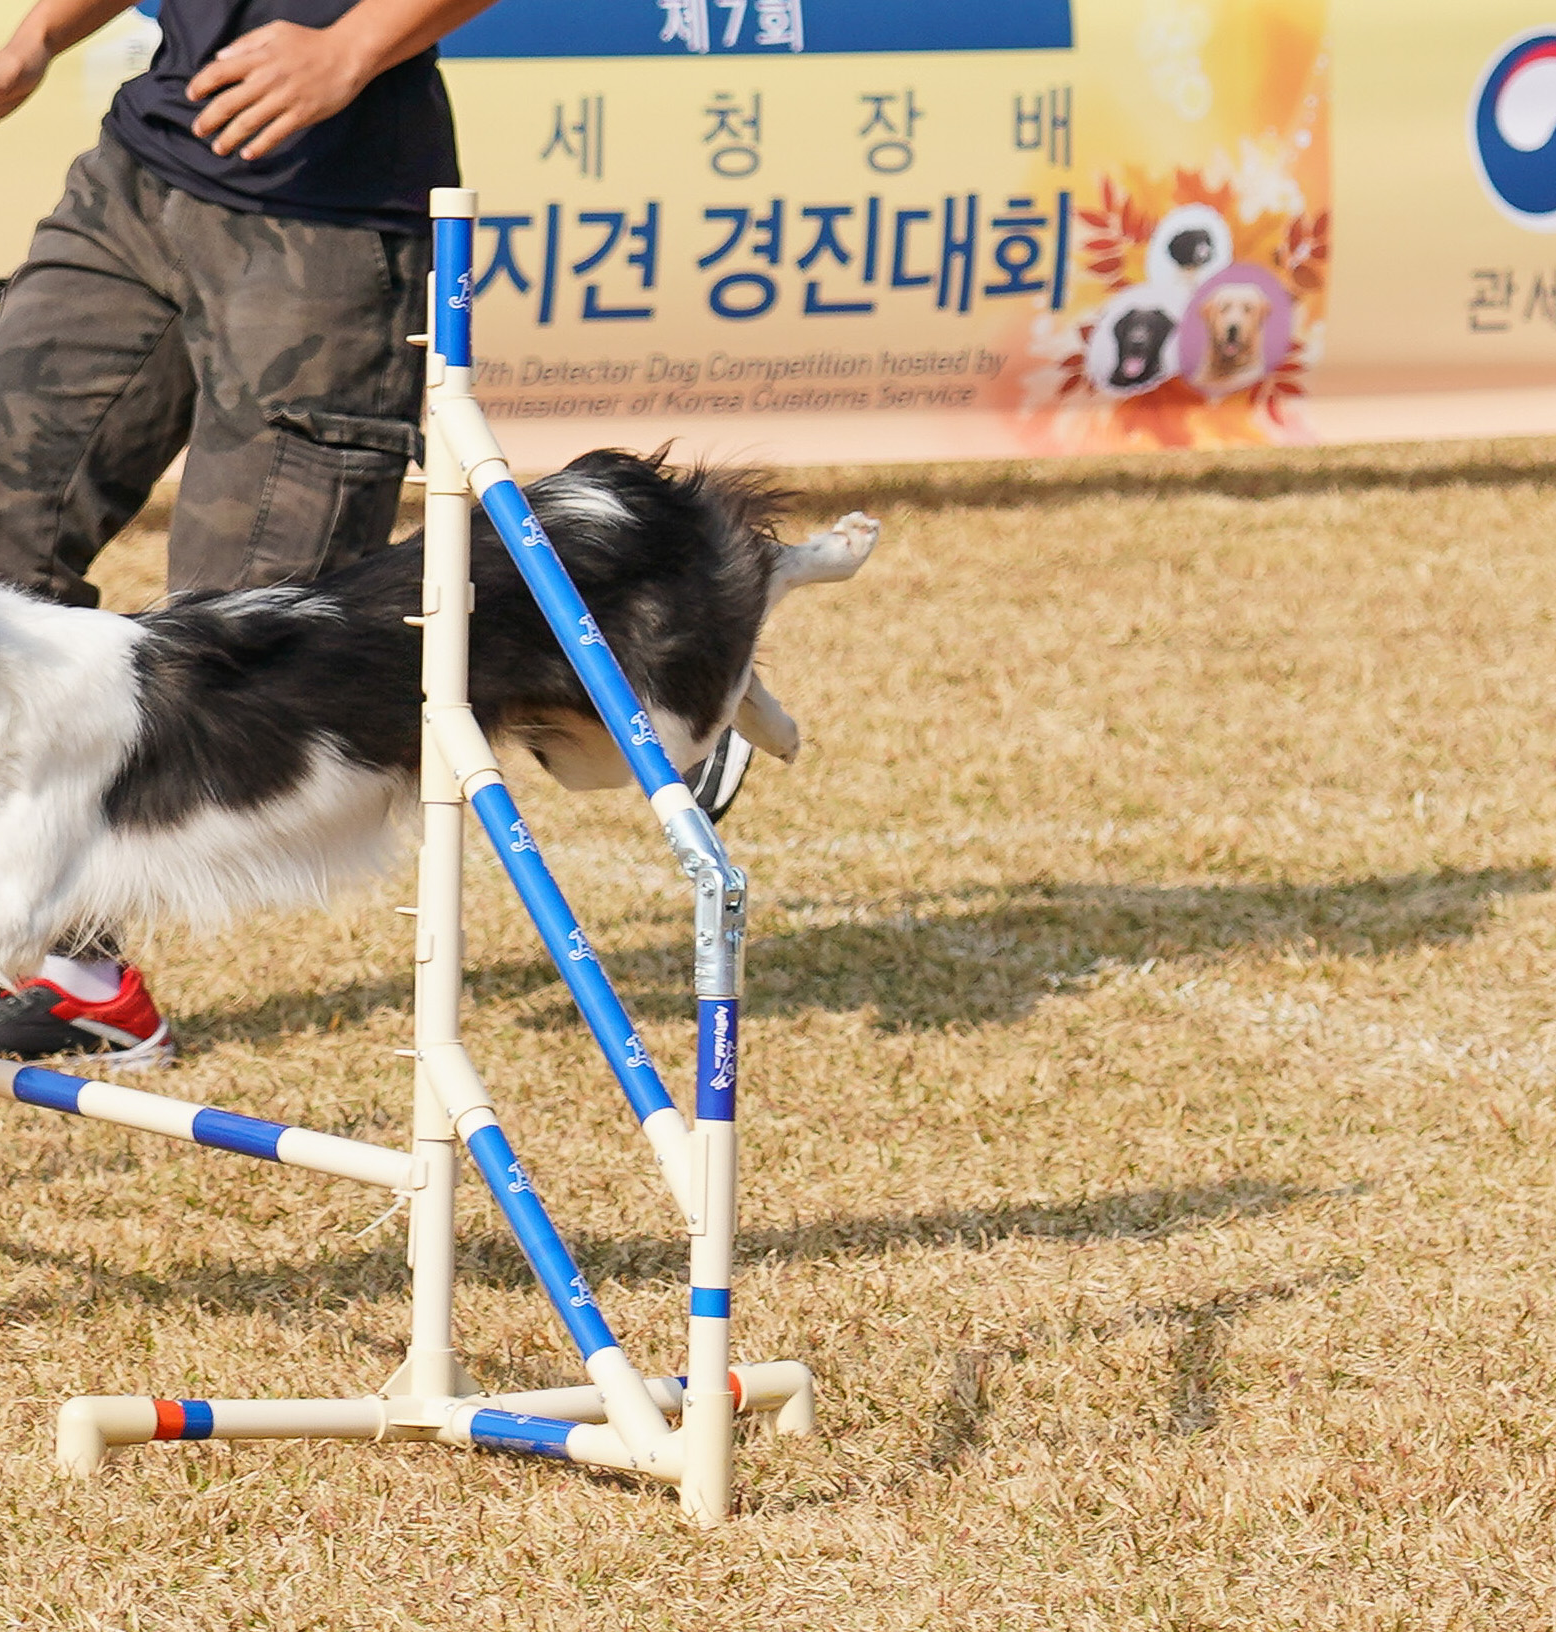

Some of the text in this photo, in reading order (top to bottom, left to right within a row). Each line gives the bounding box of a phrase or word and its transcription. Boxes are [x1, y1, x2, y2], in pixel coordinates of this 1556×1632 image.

[696, 190, 1074, 323] 경진대회
[519, 353, 639, 388] Detector
[646, 351, 700, 390] Dog
[707, 347, 873, 385] Competition
[878, 345, 969, 380] hosted
[975, 344, 1009, 381] by
[629, 389, 659, 416] of
[663, 386, 744, 415] Korea
[751, 382, 869, 414] Customs
[878, 380, 975, 410] Service
